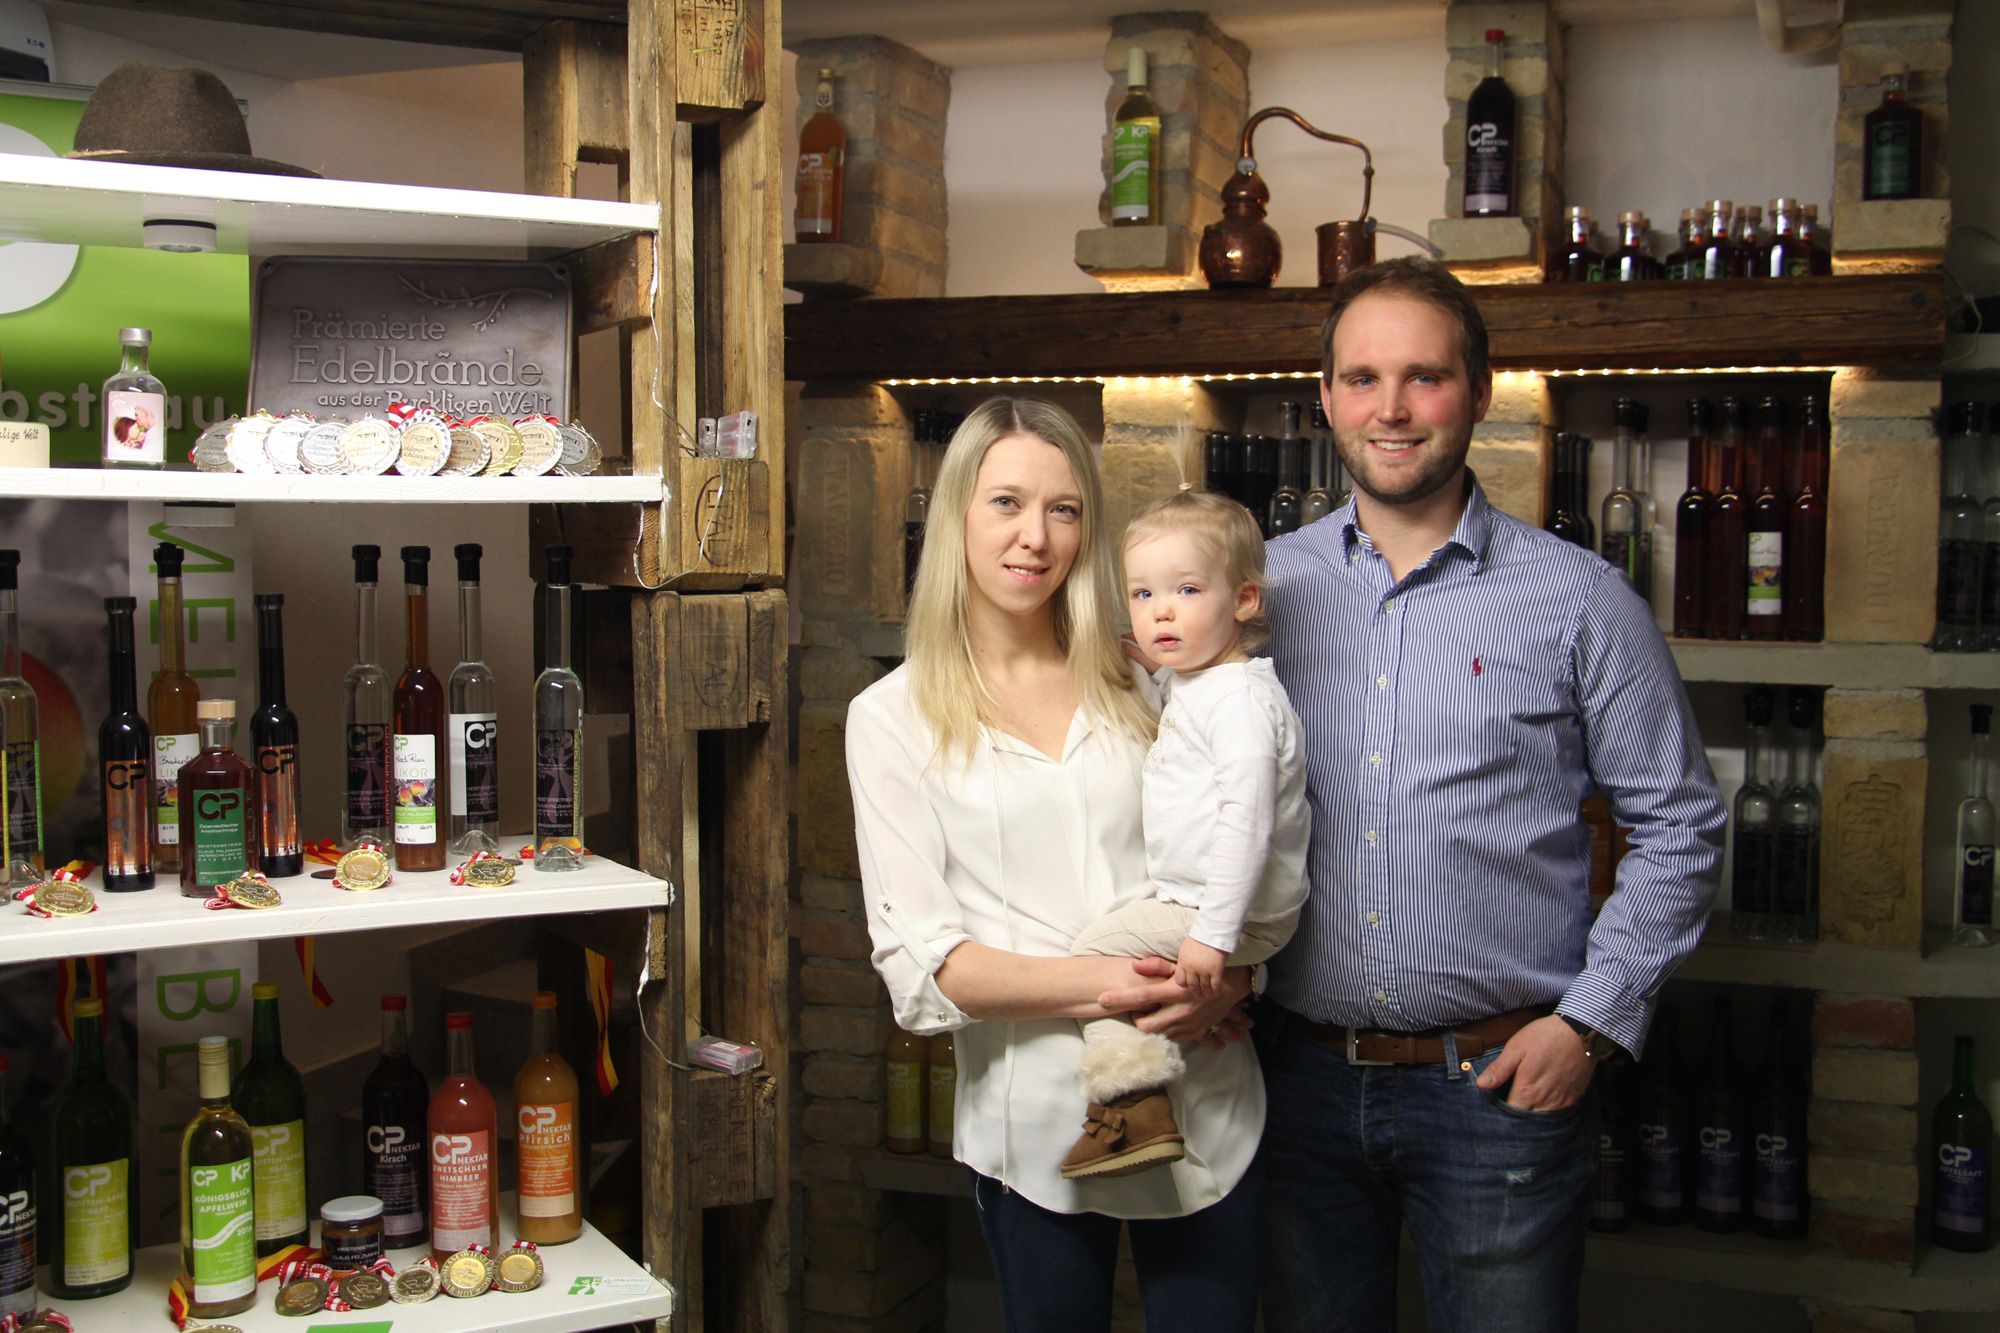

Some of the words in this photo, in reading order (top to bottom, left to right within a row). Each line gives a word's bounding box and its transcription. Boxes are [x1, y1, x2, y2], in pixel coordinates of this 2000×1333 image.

[1468, 123, 1498, 147] CP
[800, 153, 822, 175] CP
[292, 308, 446, 341] Prämierte
[289, 345, 543, 386] Edelbrände
[318, 394, 346, 407] aus
[351, 391, 382, 407] der
[493, 390, 552, 415] Welt
[156, 737, 176, 751] CP
[395, 736, 408, 751] CP
[466, 723, 497, 749] CP
[260, 749, 295, 775] CP
[108, 764, 145, 790] CP
[198, 793, 240, 820] CP
[1965, 847, 1993, 866] CP
[519, 1106, 556, 1135] CP
[543, 1123, 572, 1134] NEKTAR
[252, 1127, 290, 1157] CP
[367, 1125, 405, 1154] CP
[520, 1133, 570, 1145] Pfirsich
[1640, 1123, 1668, 1146] CP
[1700, 1126, 1731, 1149] CP
[1756, 1133, 1787, 1156] CP
[380, 1154, 407, 1163] Kirsch
[390, 1142, 420, 1154] NEKTAR
[433, 1135, 472, 1164] CP
[457, 1153, 488, 1165] NEKTAR
[1939, 1143, 1971, 1168] CP
[193, 1169, 218, 1187] CP
[231, 1162, 250, 1183] KP
[433, 1163, 488, 1174] ZWETSCHKEN
[440, 1173, 480, 1182] HIMBEER
[66, 1167, 112, 1198] CP
[200, 1199, 247, 1213] APFELWEIN
